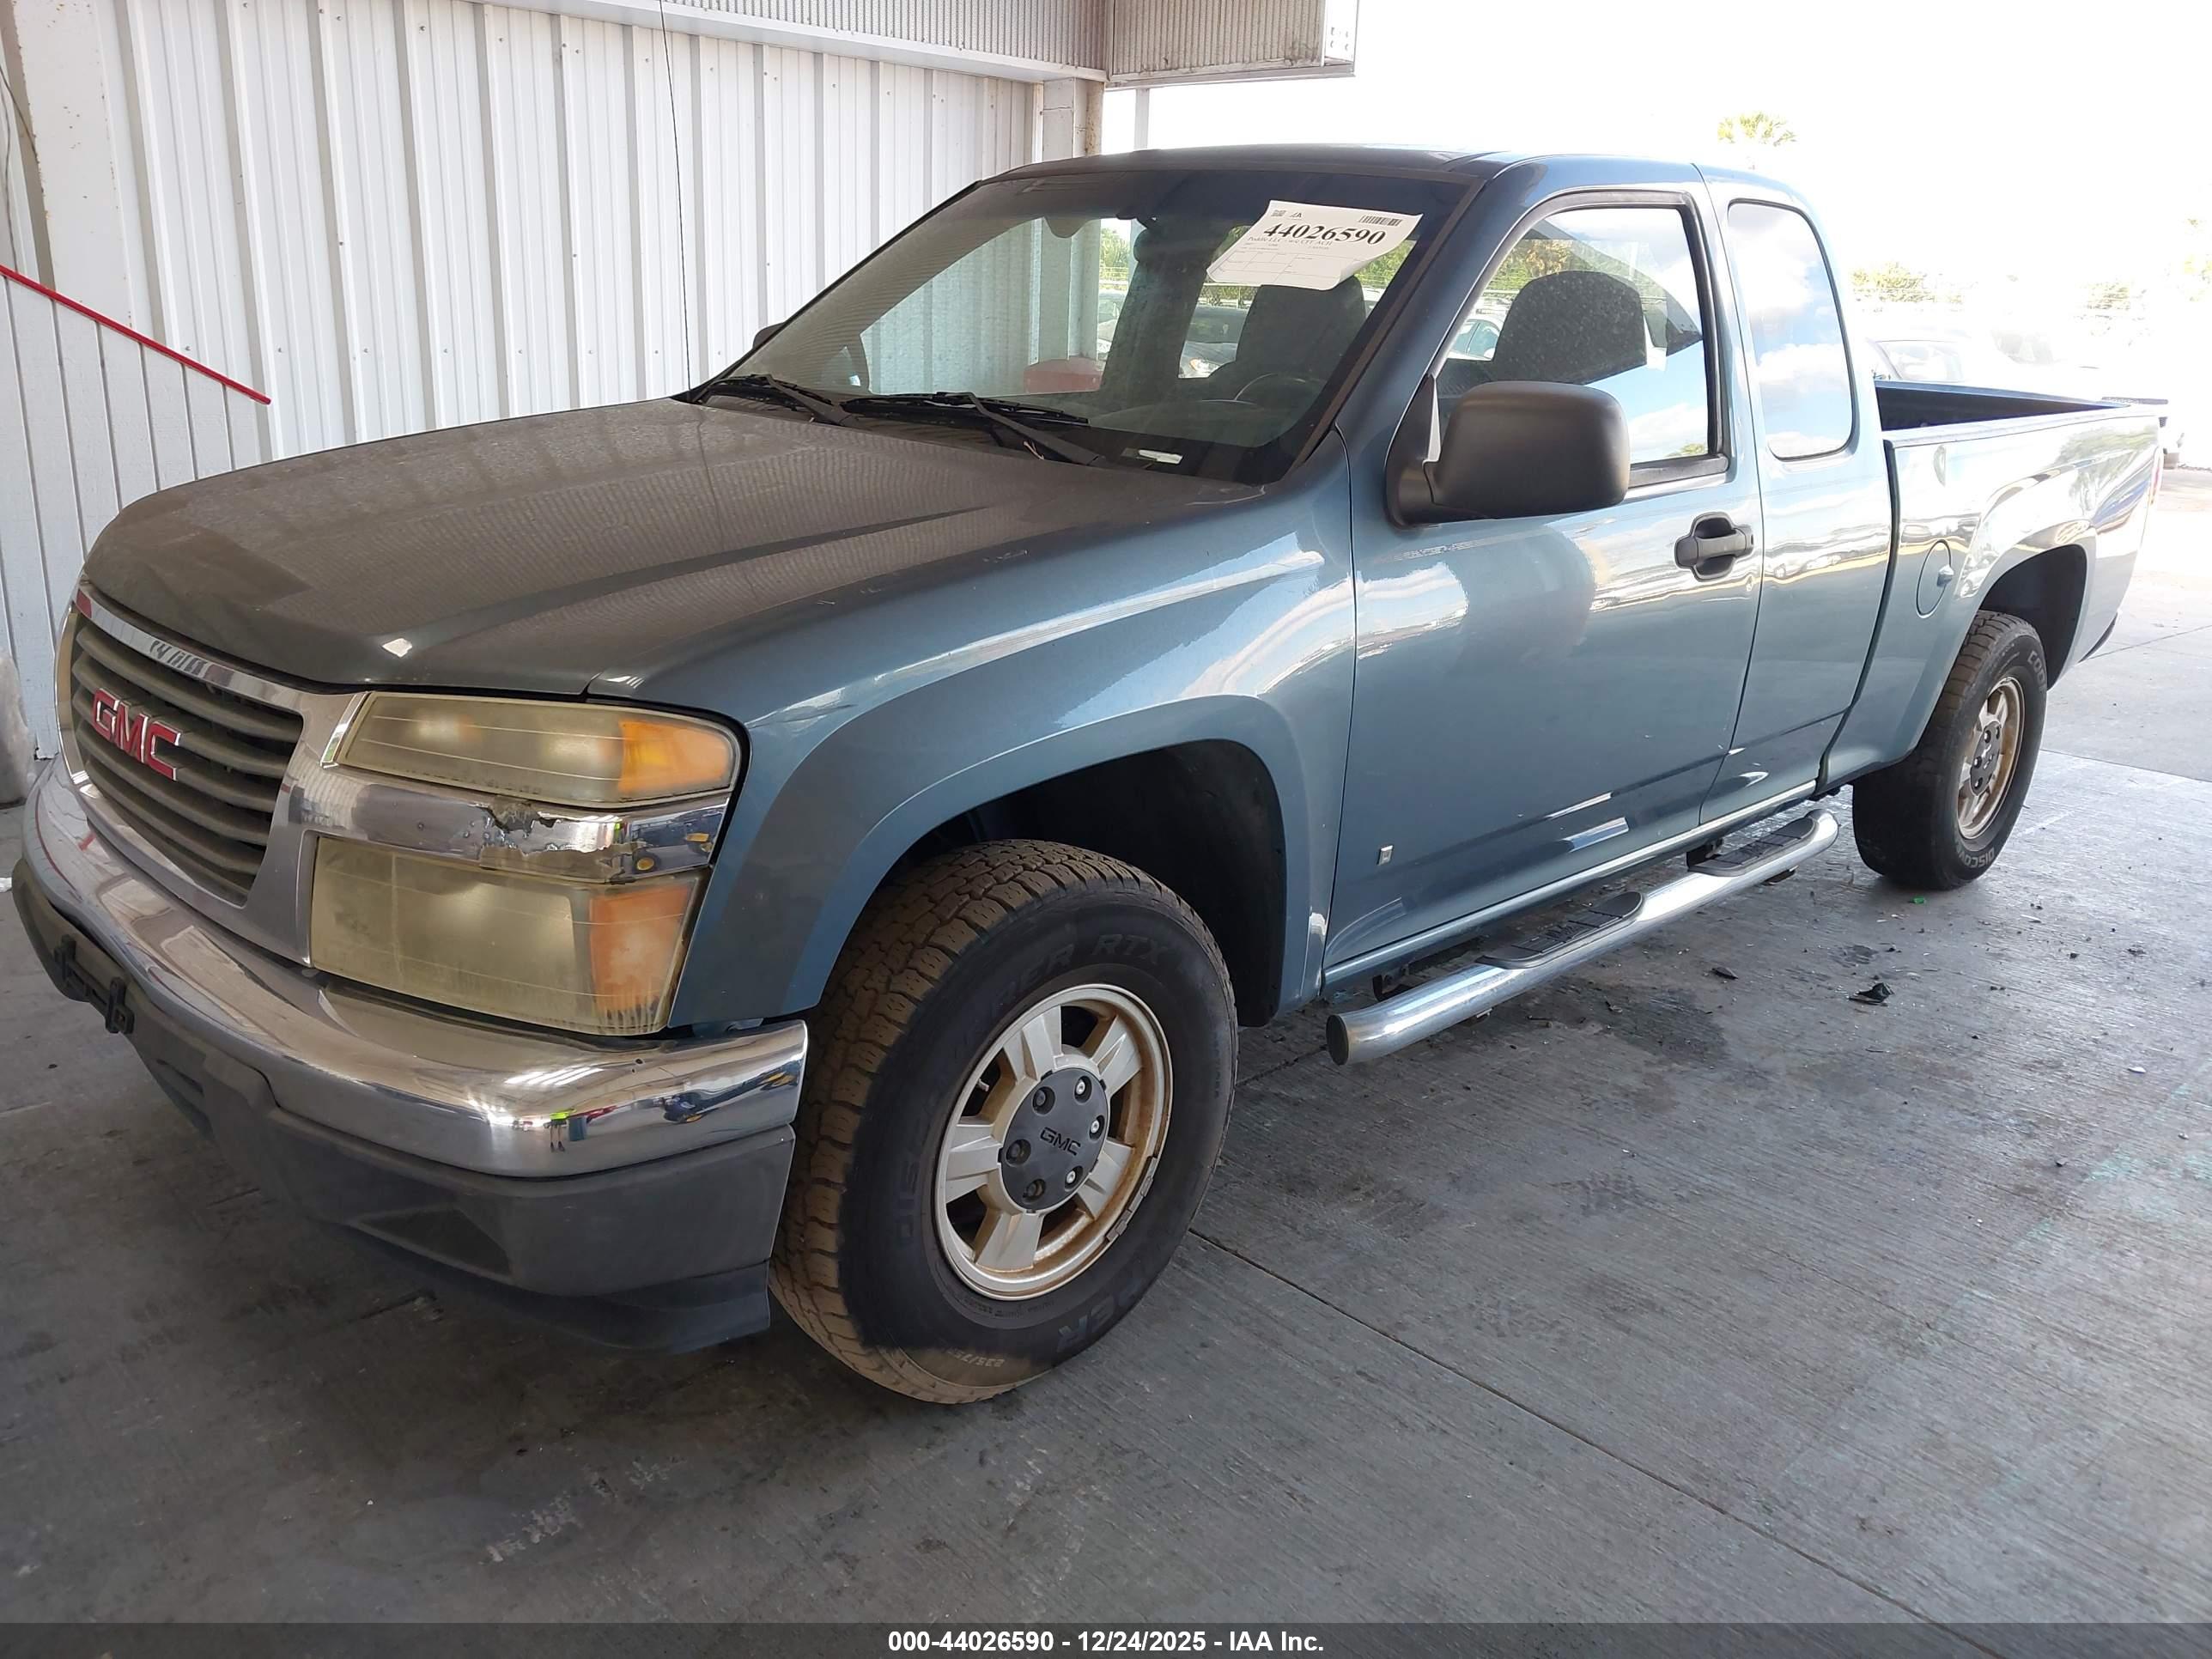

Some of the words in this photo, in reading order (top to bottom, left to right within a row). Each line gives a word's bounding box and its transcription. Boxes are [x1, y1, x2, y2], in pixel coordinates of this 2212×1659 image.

[1263, 223, 1386, 245] 44026590
[91, 688, 182, 781] GMC
[1040, 1127, 1082, 1157] GMC
